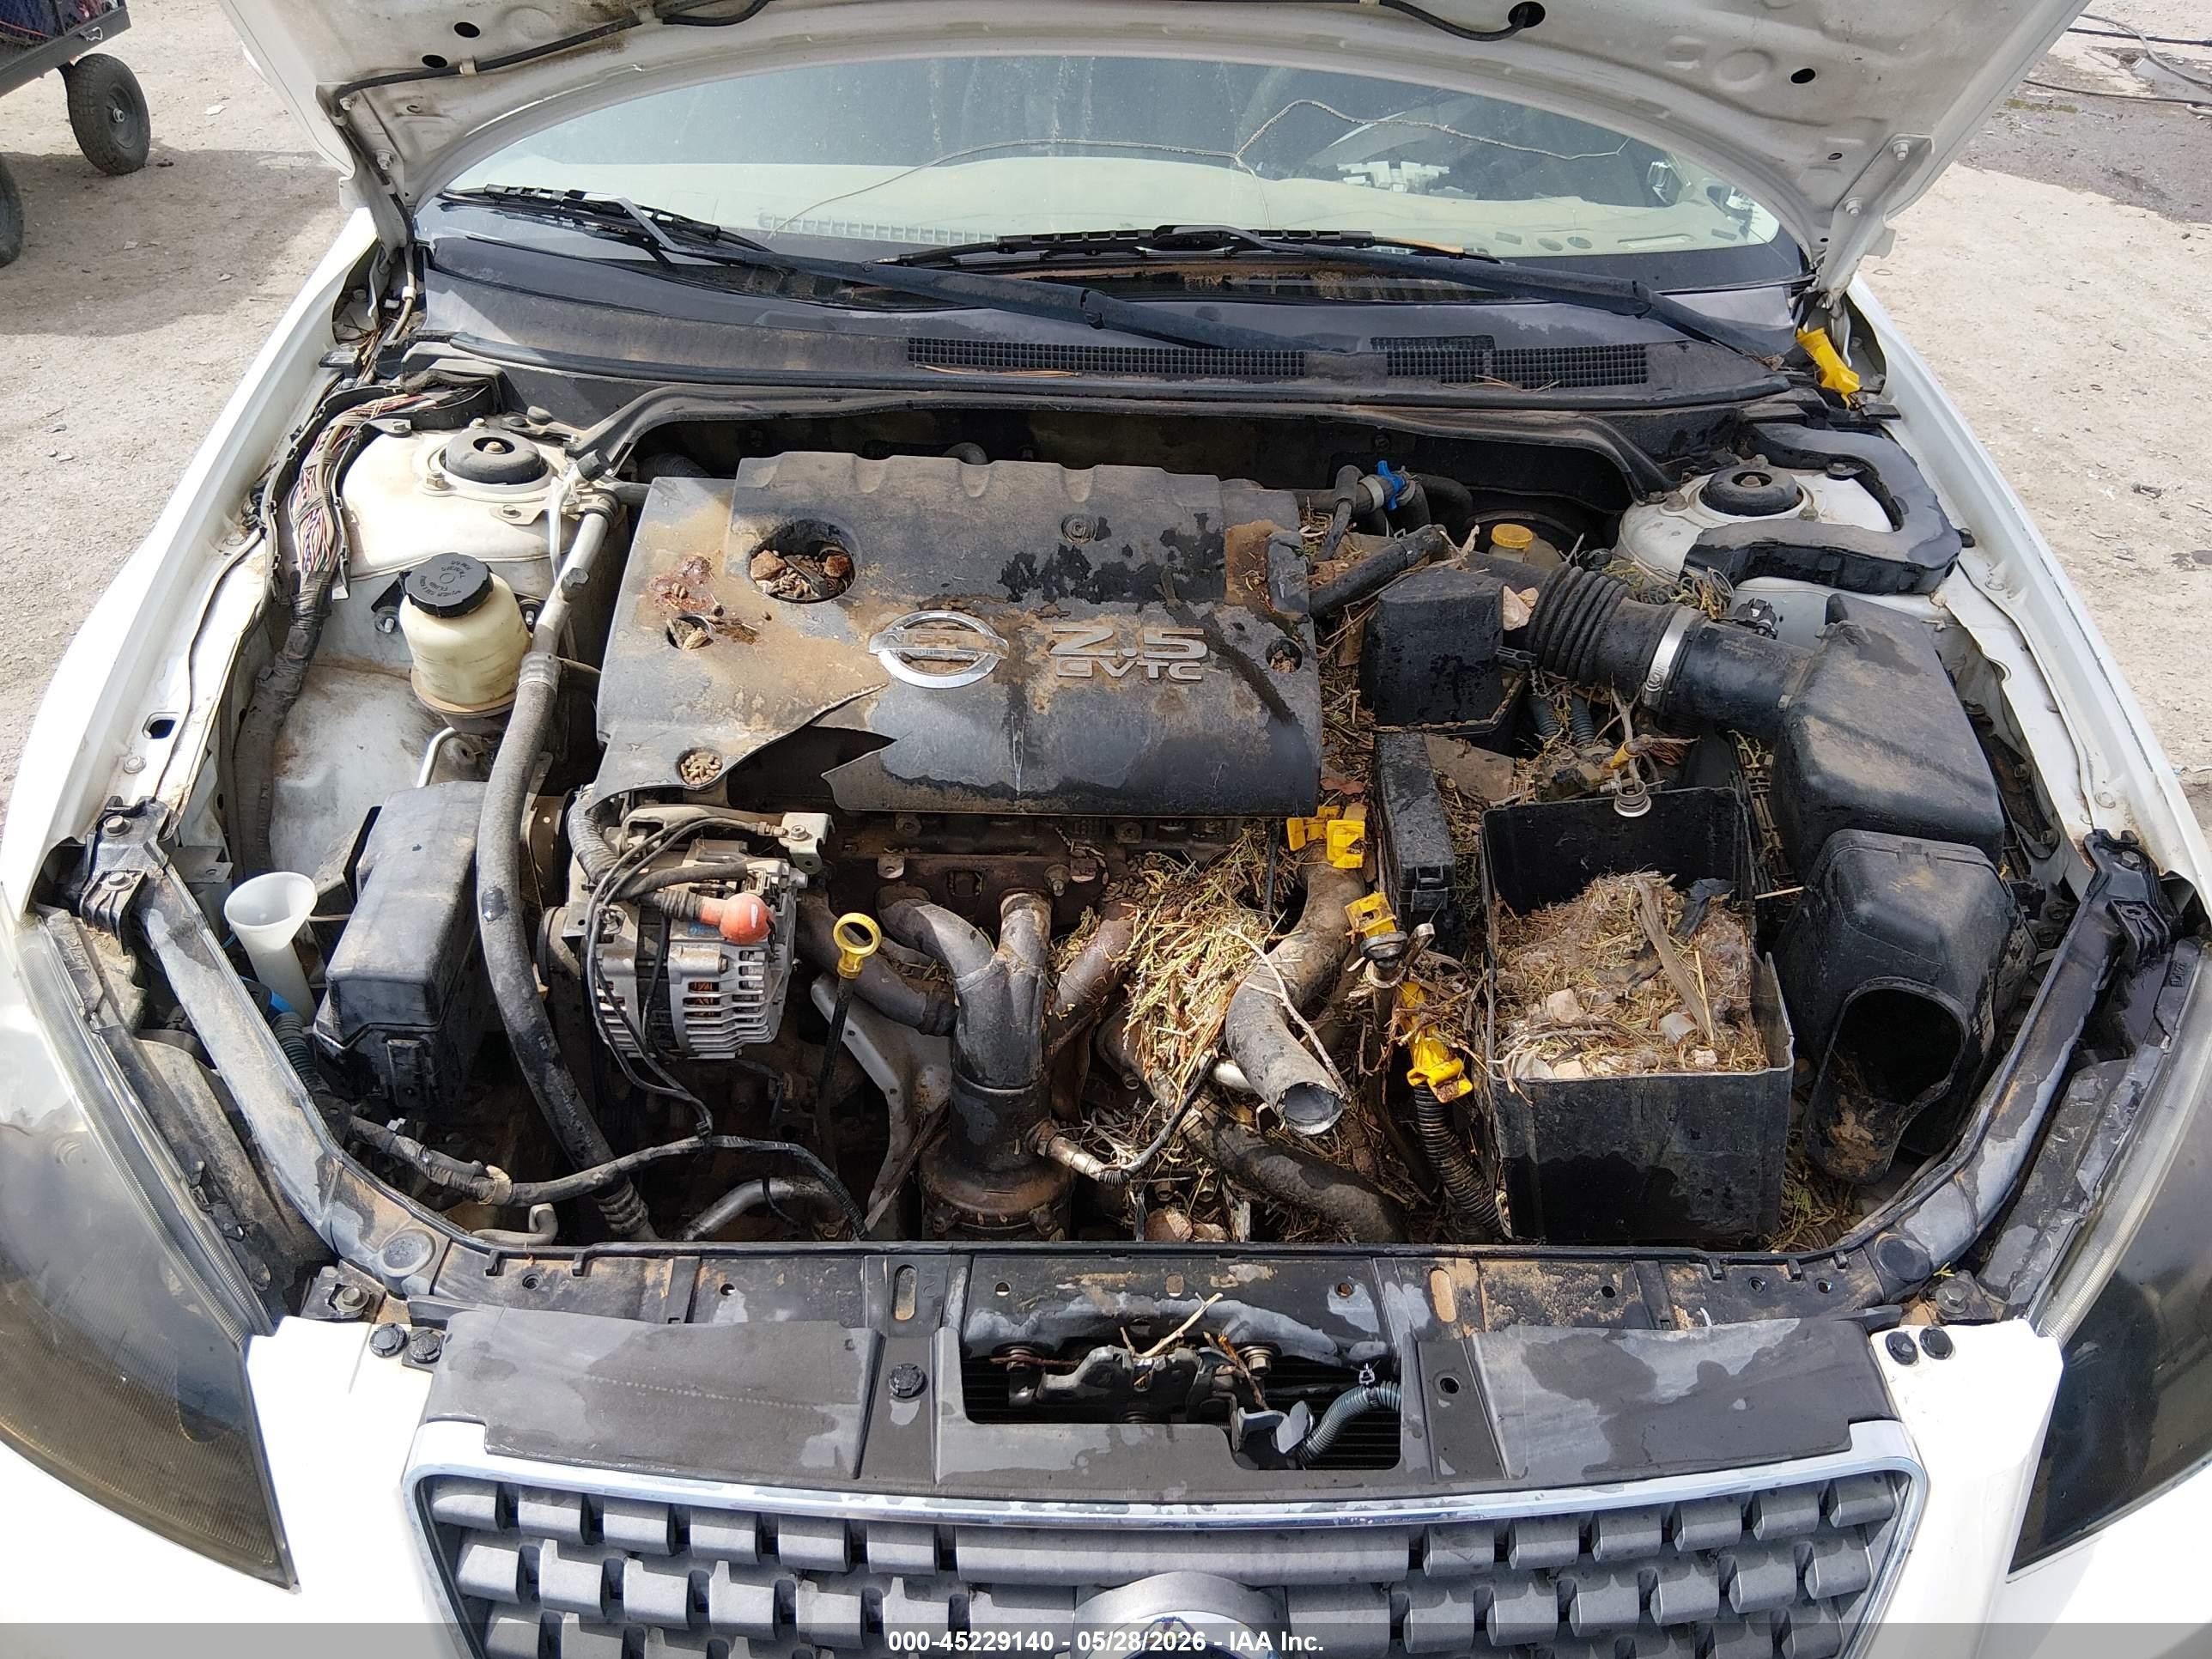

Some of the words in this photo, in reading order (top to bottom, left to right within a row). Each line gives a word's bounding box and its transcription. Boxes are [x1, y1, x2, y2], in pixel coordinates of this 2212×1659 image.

[884, 630, 990, 650] NISS
[1050, 626, 1207, 659] 2.5
[1057, 657, 1202, 680] CVTC
